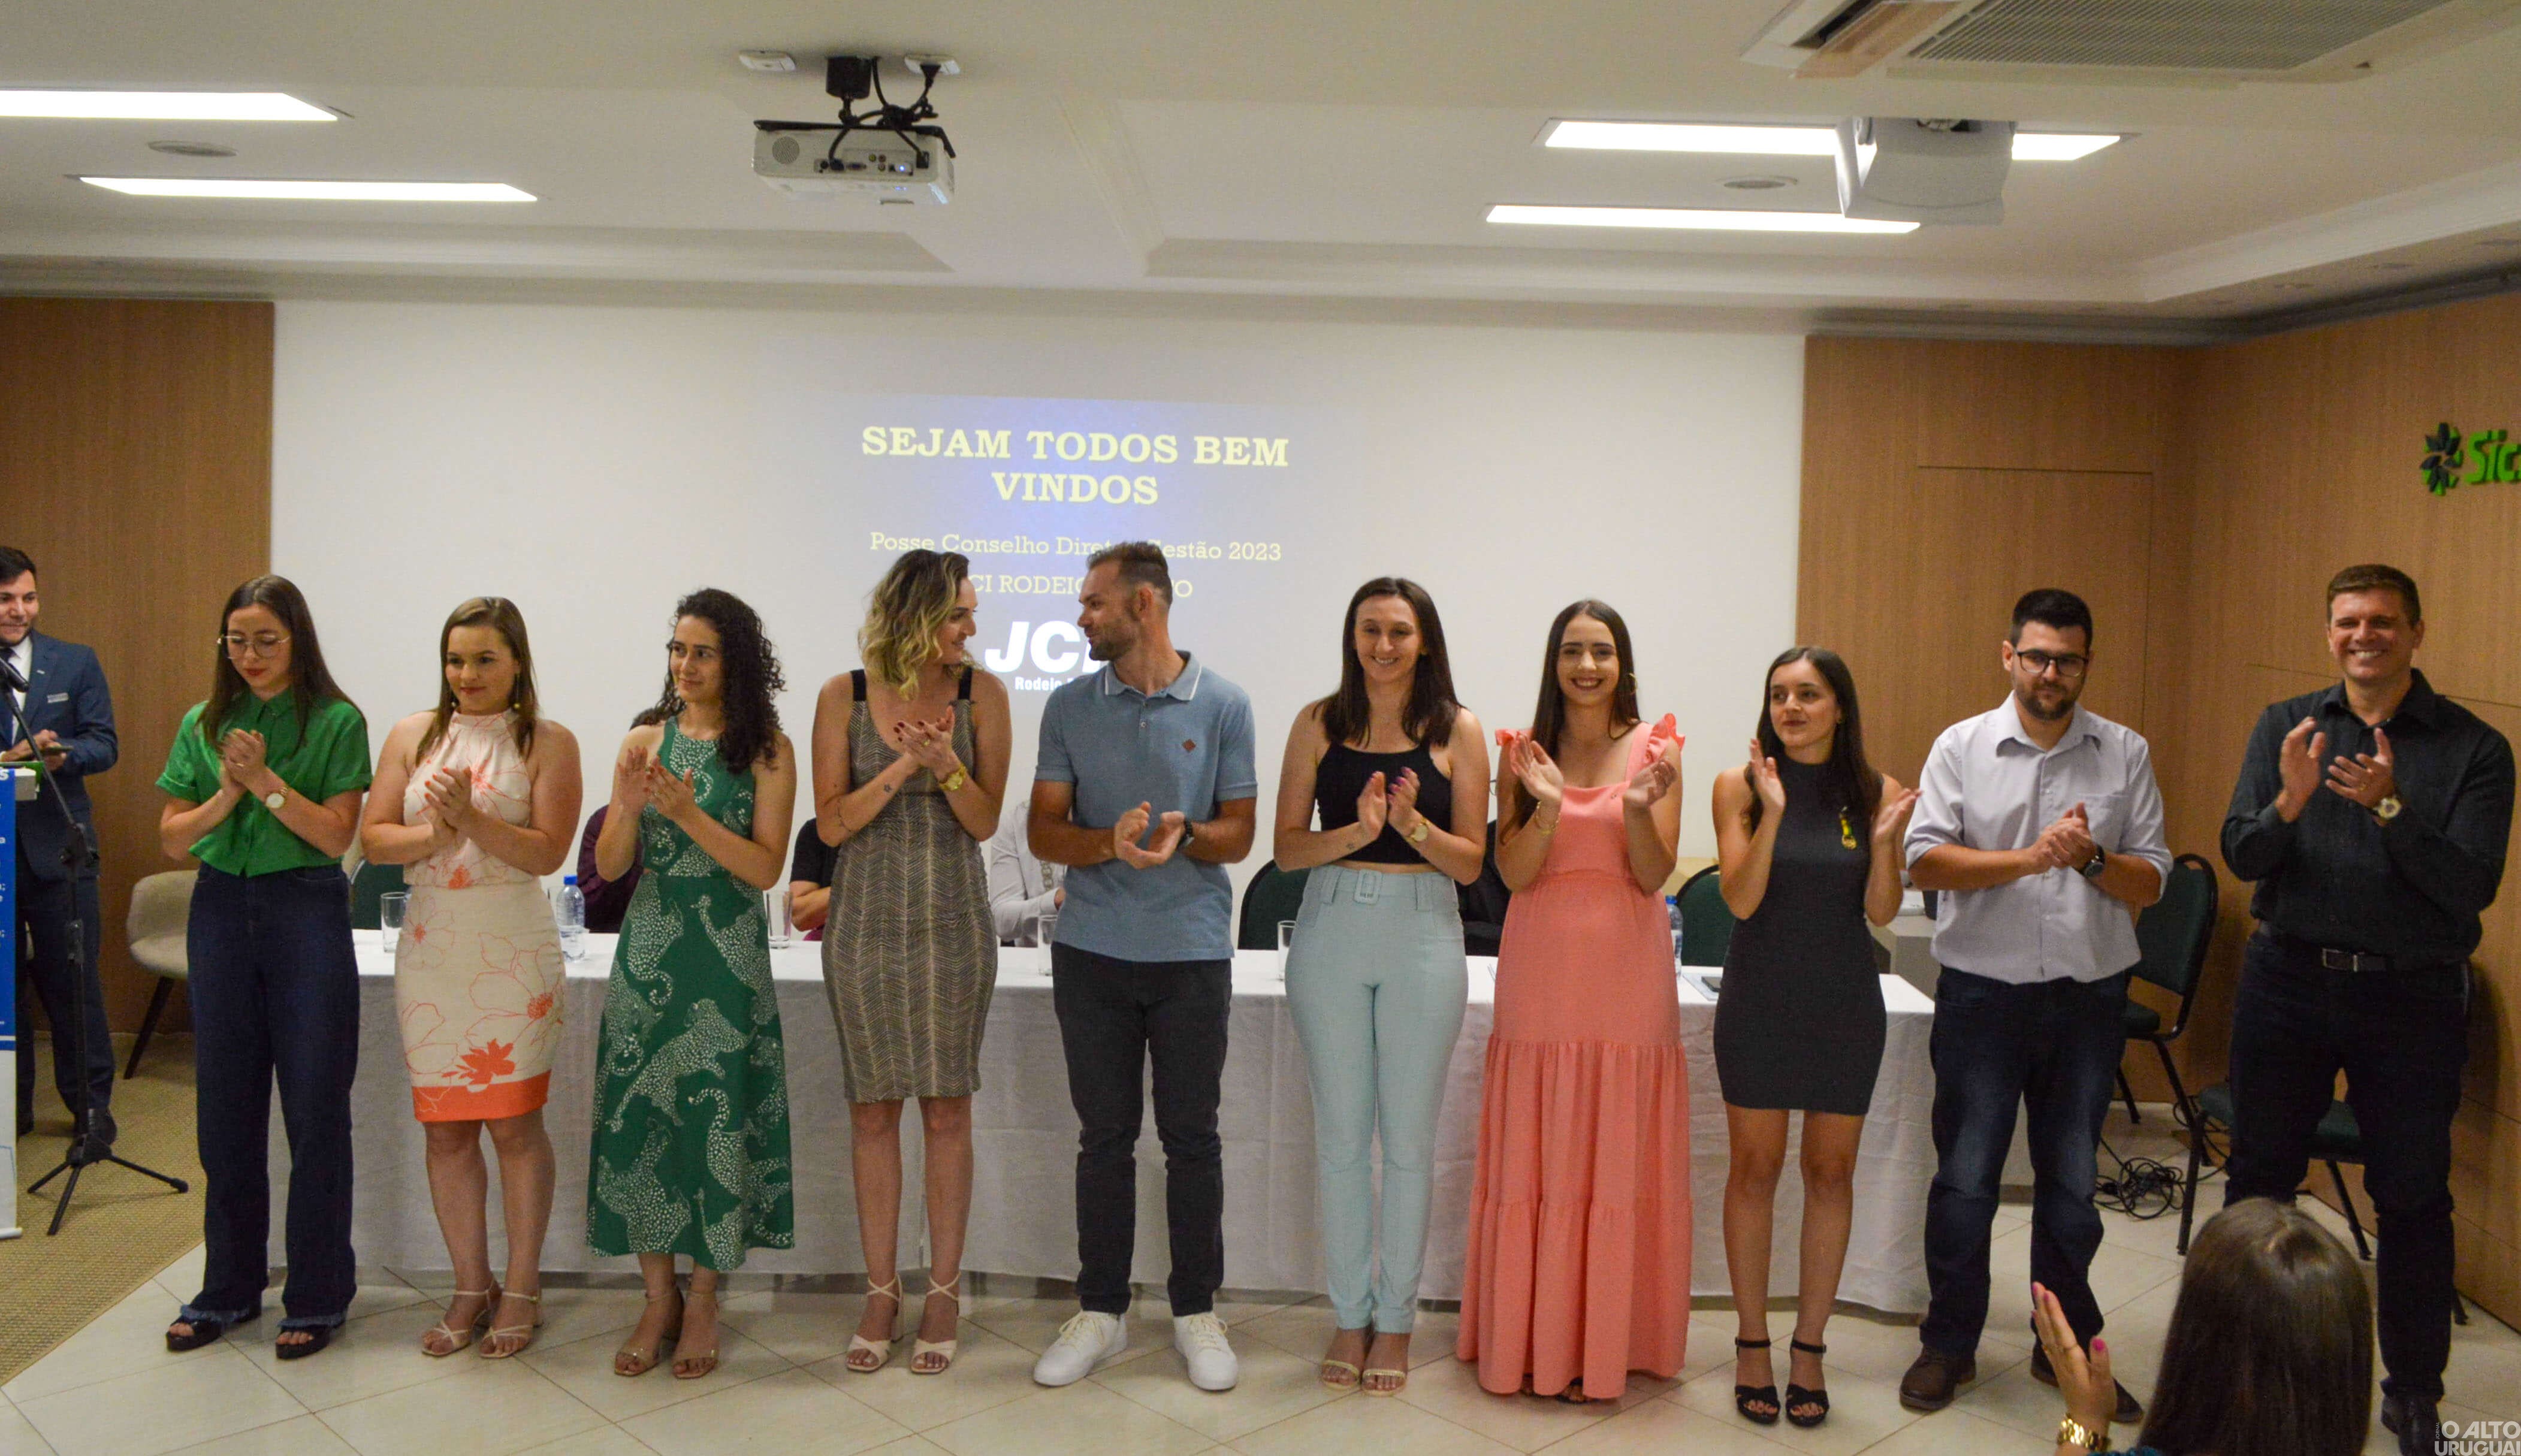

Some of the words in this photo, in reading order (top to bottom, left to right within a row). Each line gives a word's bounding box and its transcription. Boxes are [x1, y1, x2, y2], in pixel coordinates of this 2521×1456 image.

[862, 426, 1012, 458] SEJAM
[1026, 431, 1178, 464] TODOS
[1193, 436, 1290, 467] BEM
[2465, 430, 2521, 484] Sic
[991, 472, 1159, 505] VINDOS
[870, 531, 935, 551] Posse
[941, 533, 1050, 555] Conselho
[1055, 536, 1112, 555] Diret
[1228, 542, 1282, 561] 2023
